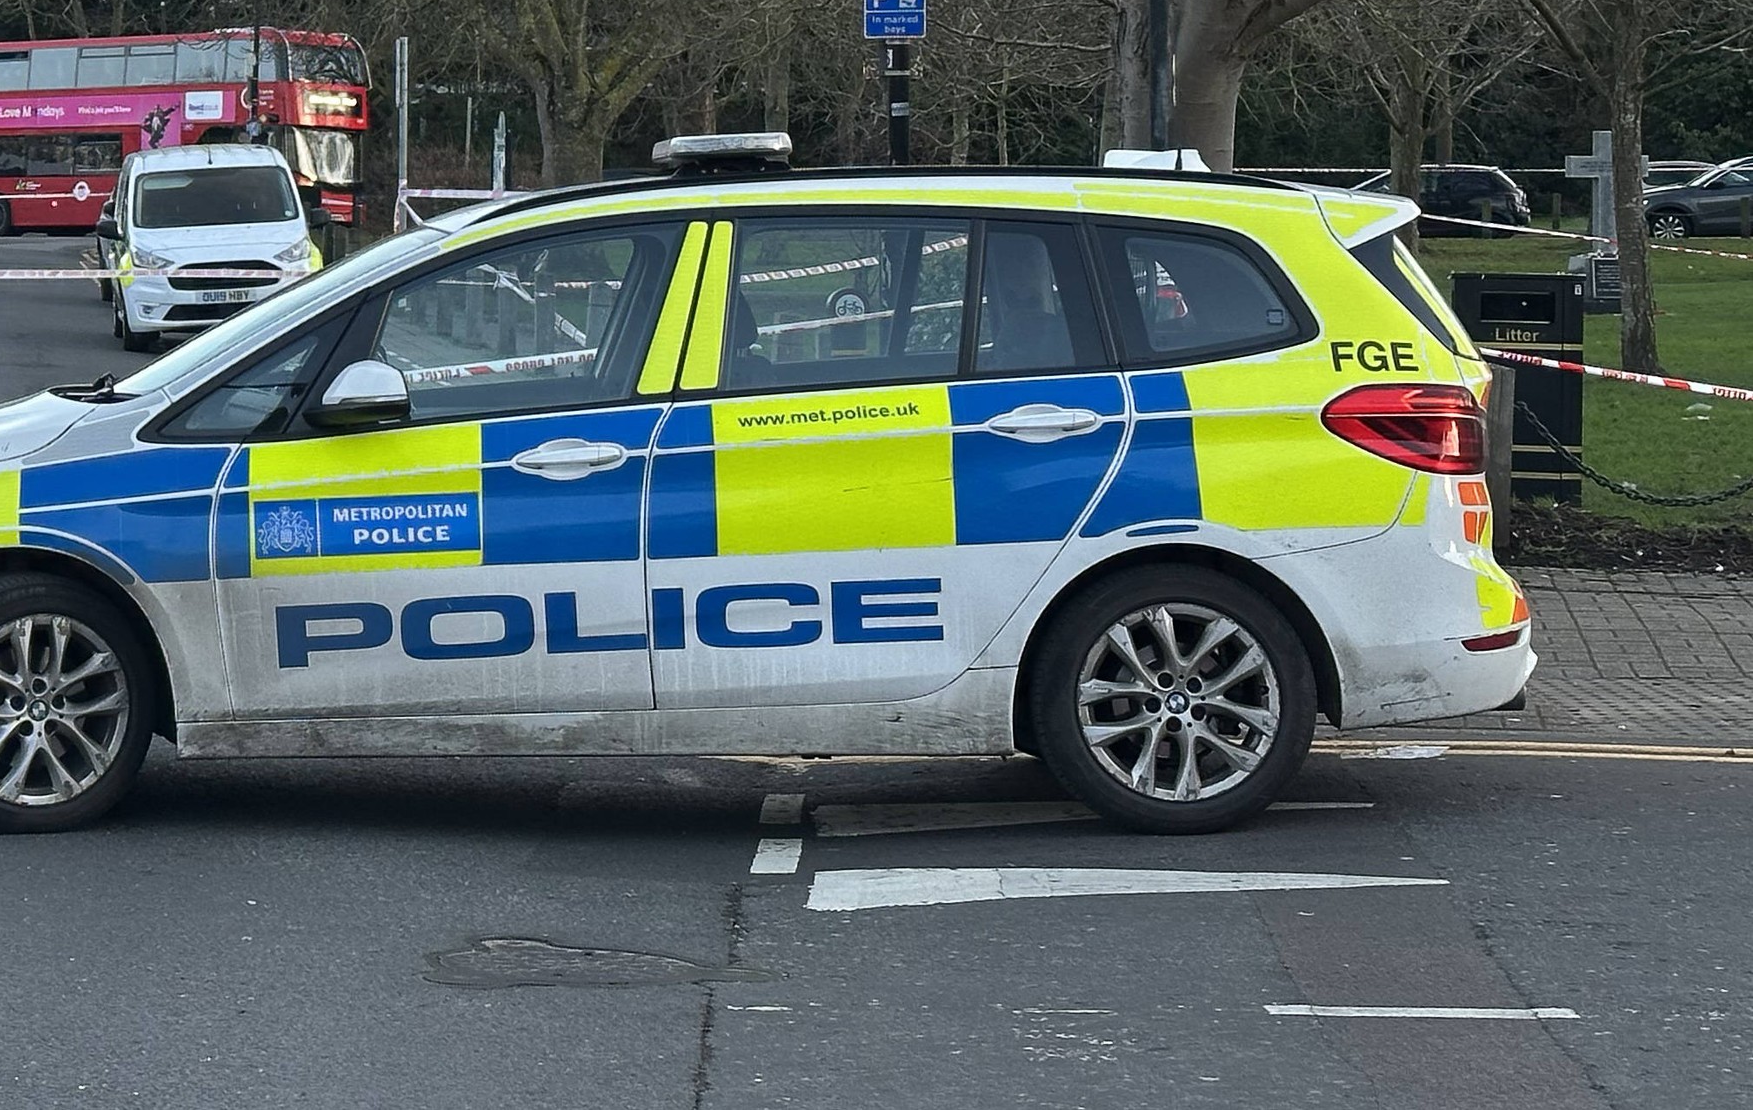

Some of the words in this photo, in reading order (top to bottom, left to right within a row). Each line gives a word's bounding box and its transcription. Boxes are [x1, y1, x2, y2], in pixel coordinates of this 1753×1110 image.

[884, 15, 919, 24] marked
[884, 26, 906, 34] bays
[1496, 327, 1539, 341] Litter
[1331, 341, 1419, 372] FGE
[738, 402, 919, 427] www.met.police.uk
[333, 503, 468, 522] METROPOLITAN
[353, 525, 451, 545] POLICE
[274, 577, 944, 669] POLICE
